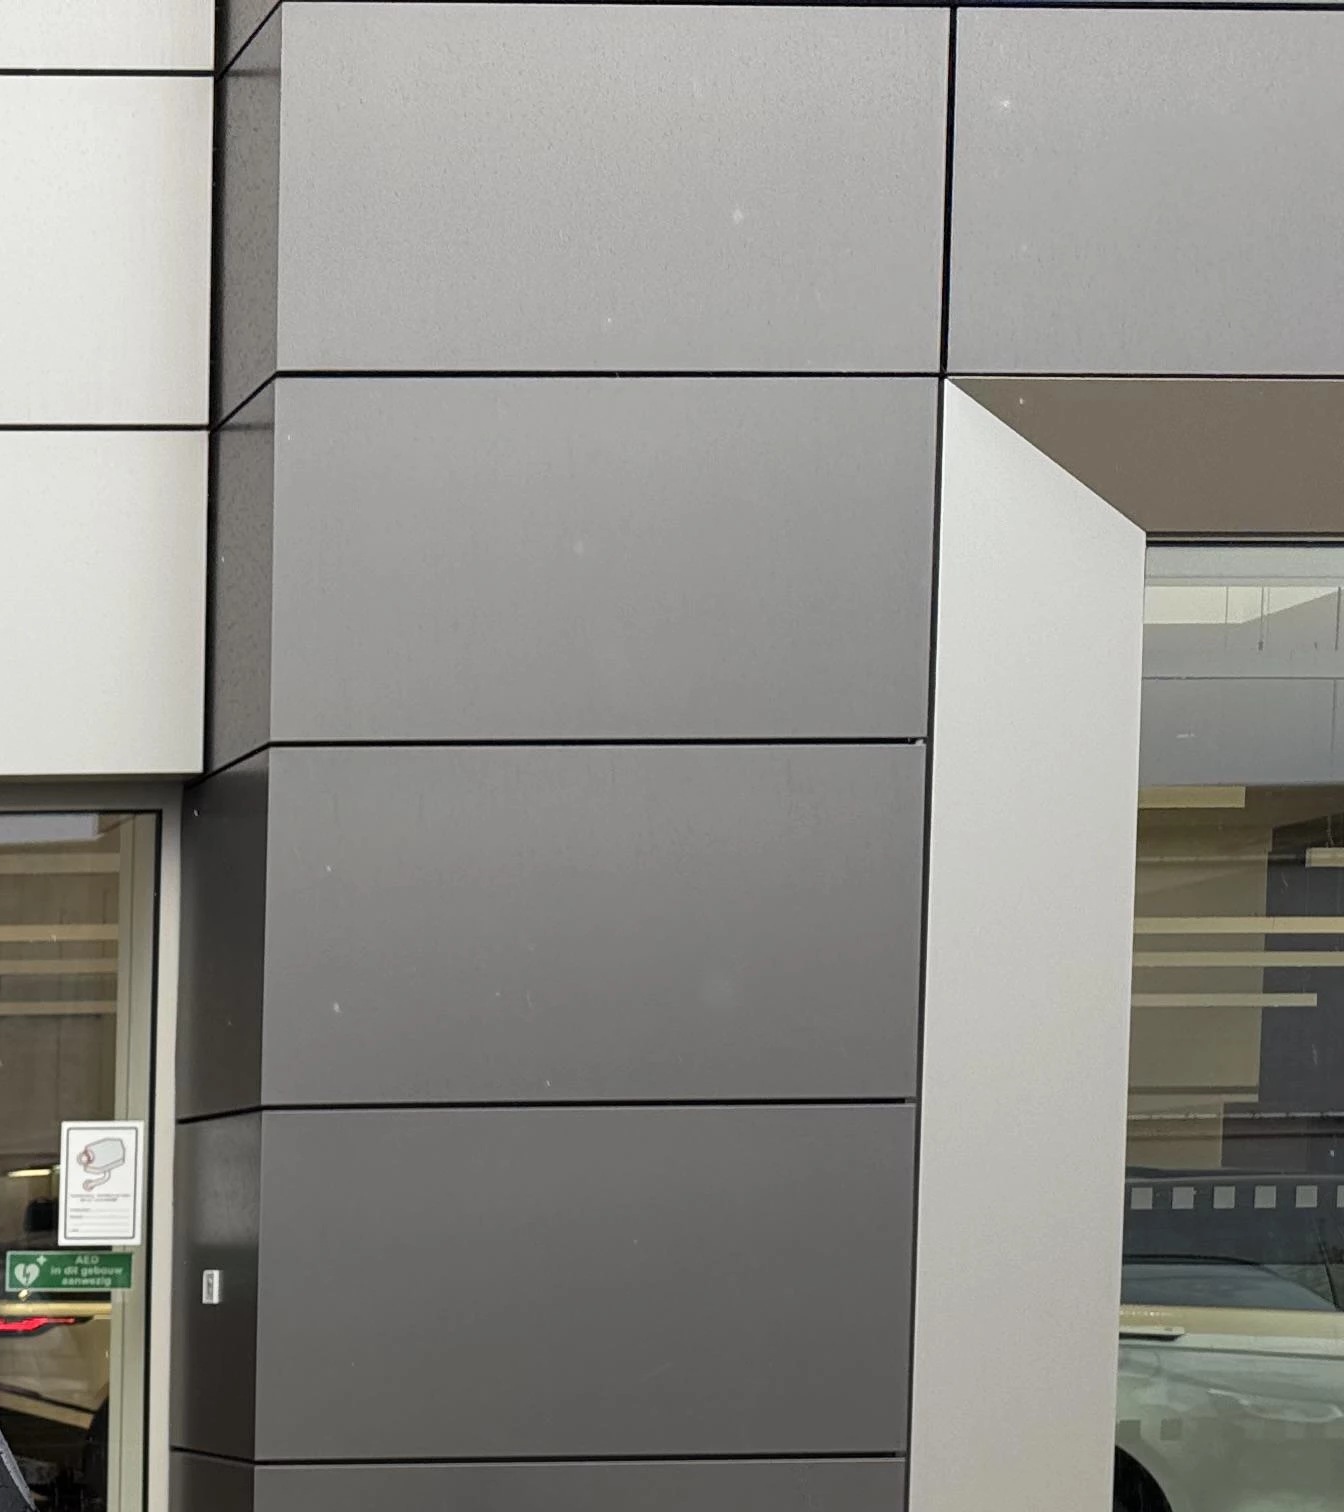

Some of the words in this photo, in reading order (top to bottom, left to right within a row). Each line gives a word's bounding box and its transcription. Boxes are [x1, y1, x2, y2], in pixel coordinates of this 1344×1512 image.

[75, 1255, 99, 1264] AED
[50, 1266, 61, 1275] in
[64, 1266, 79, 1275] dit
[81, 1266, 123, 1277] gebouw
[62, 1277, 112, 1286] aanwezig
